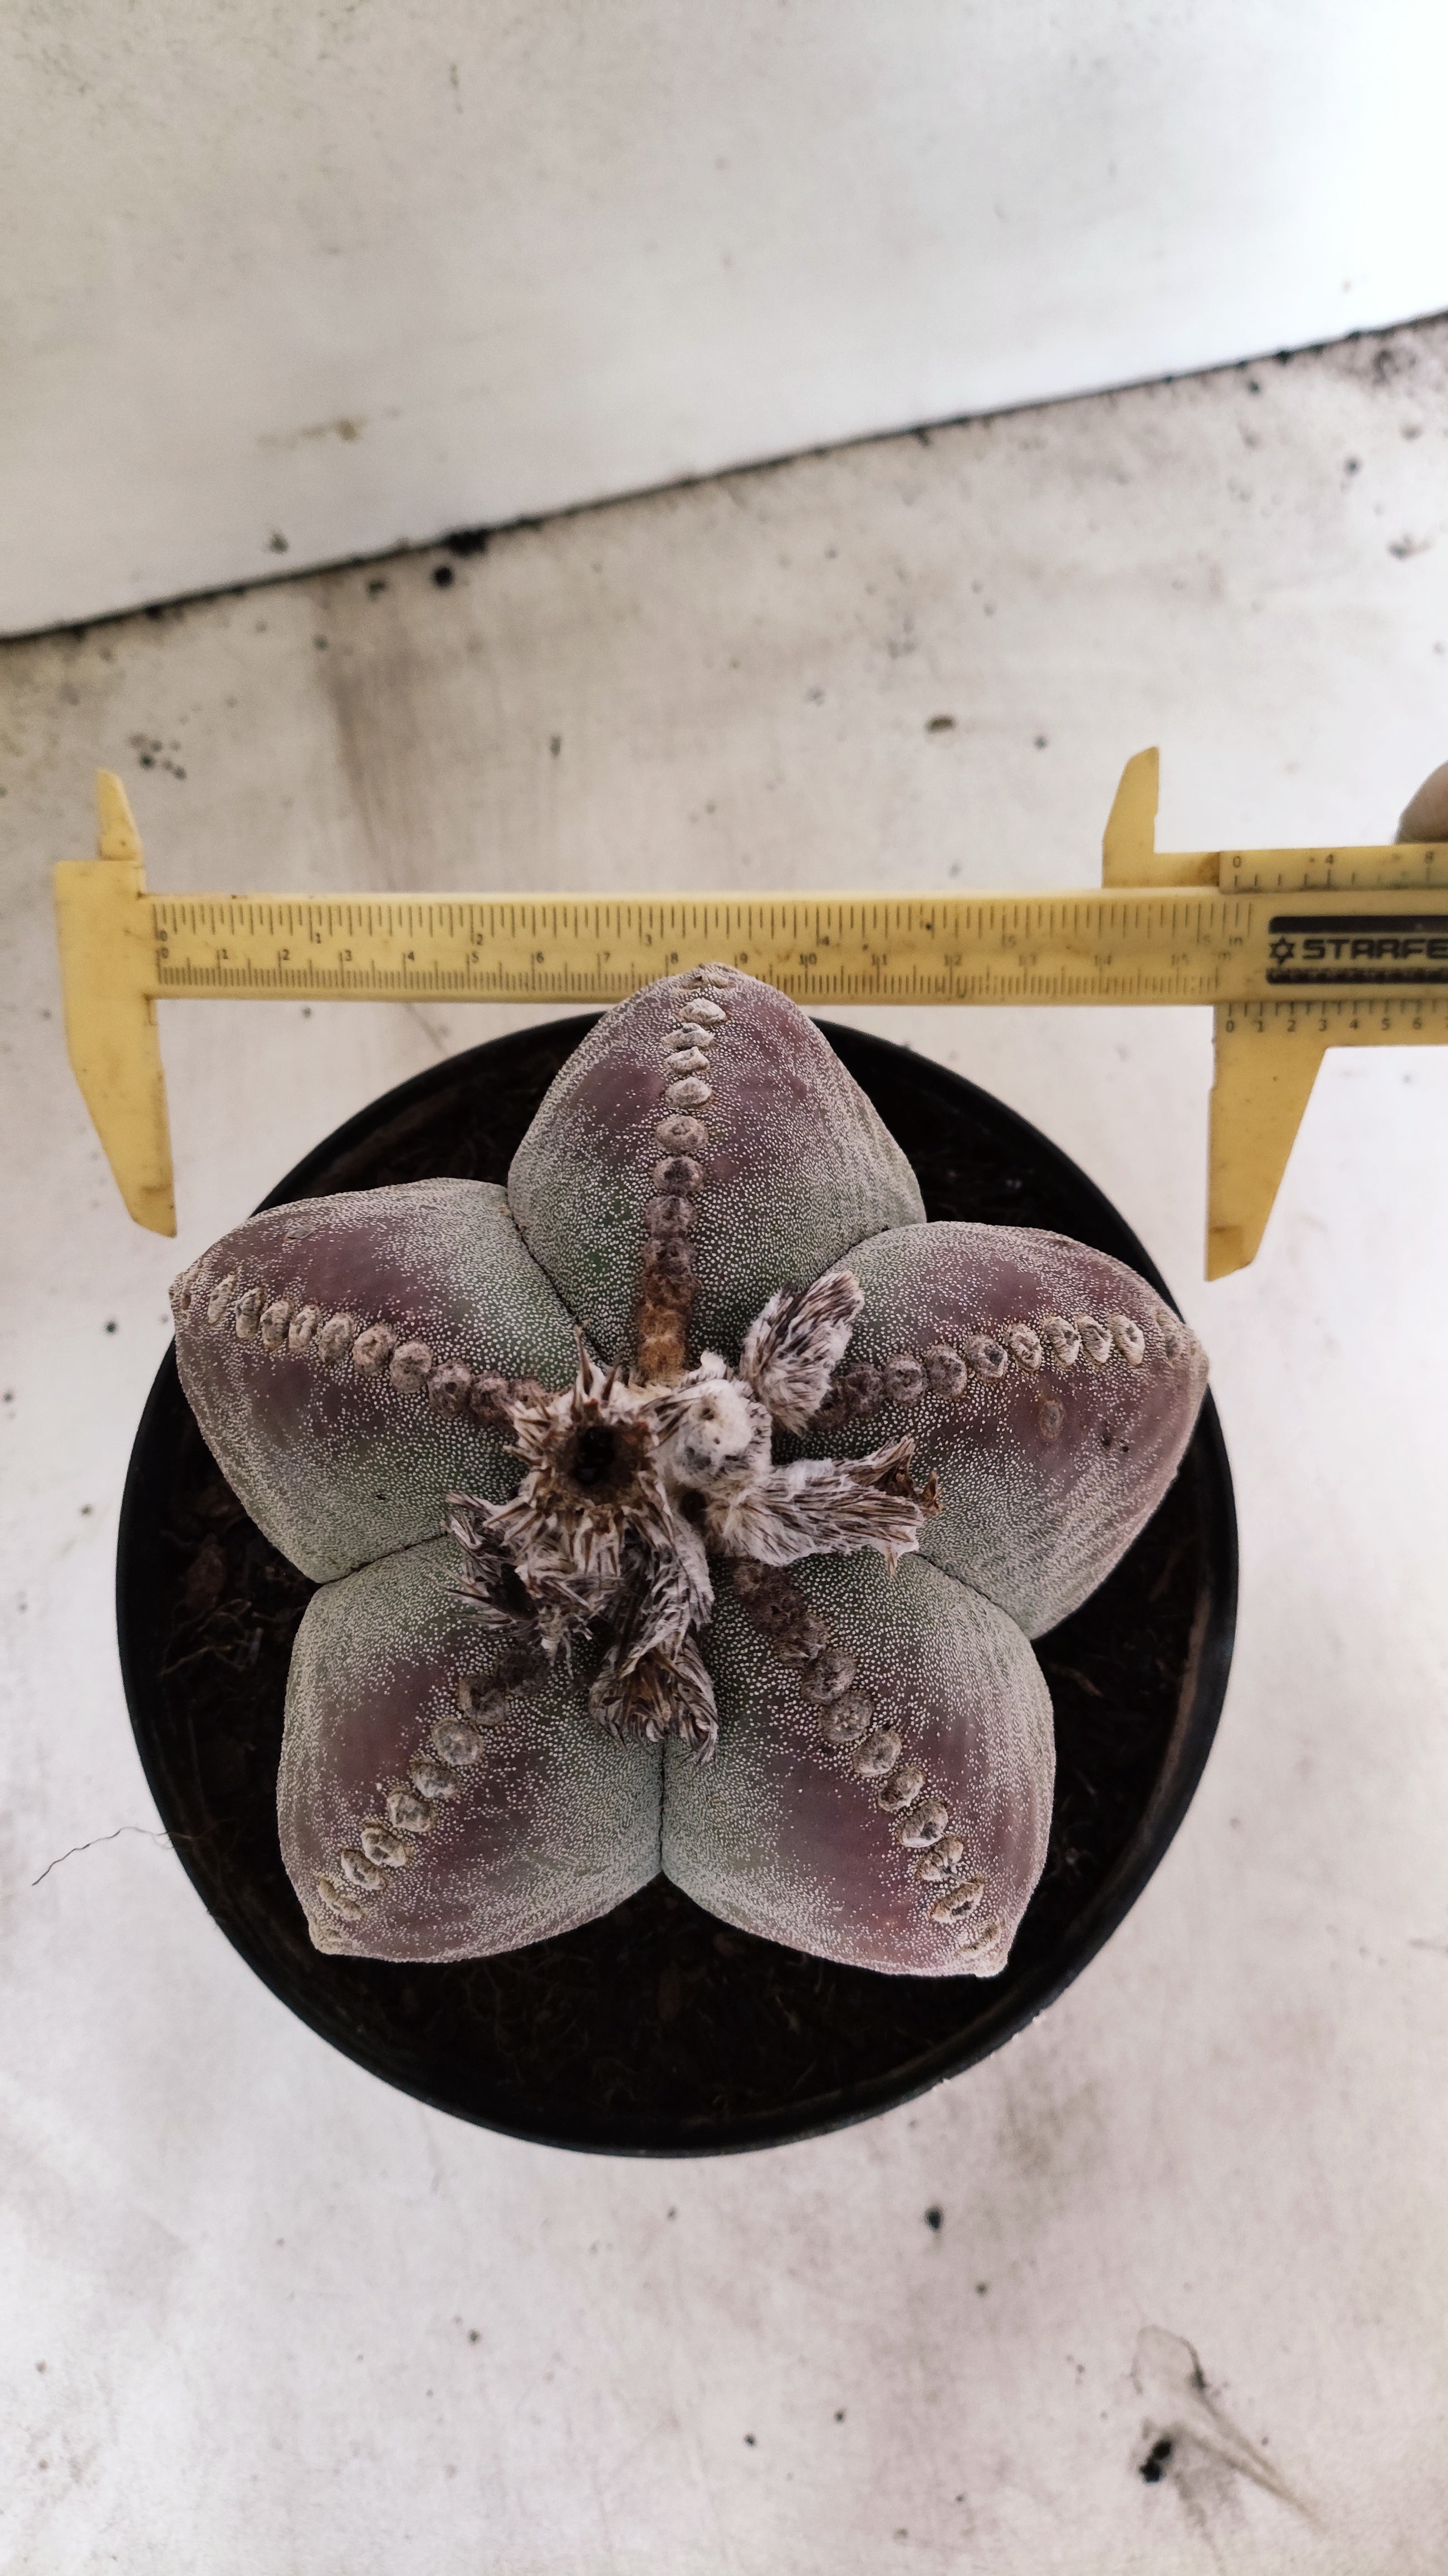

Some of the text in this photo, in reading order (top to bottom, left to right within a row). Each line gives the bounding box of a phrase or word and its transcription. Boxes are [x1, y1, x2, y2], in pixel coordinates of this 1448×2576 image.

[1232, 850, 1435, 868] 0 4 8
[159, 930, 168, 941] 0
[316, 933, 321, 944] 1
[477, 934, 483, 946] 2
[160, 948, 169, 959] 0
[222, 949, 229, 960] 1
[283, 949, 290, 960] 2
[345, 949, 352, 962] 3
[407, 950, 415, 961] 4
[472, 951, 479, 963] 5
[536, 952, 544, 963] 6
[604, 952, 611, 963] 7
[671, 952, 678, 964] 8
[740, 953, 747, 964] 9
[799, 953, 817, 965] 10
[872, 953, 887, 965] 11
[1226, 1017, 1422, 1033] 0 1 2 3 4 5 6
